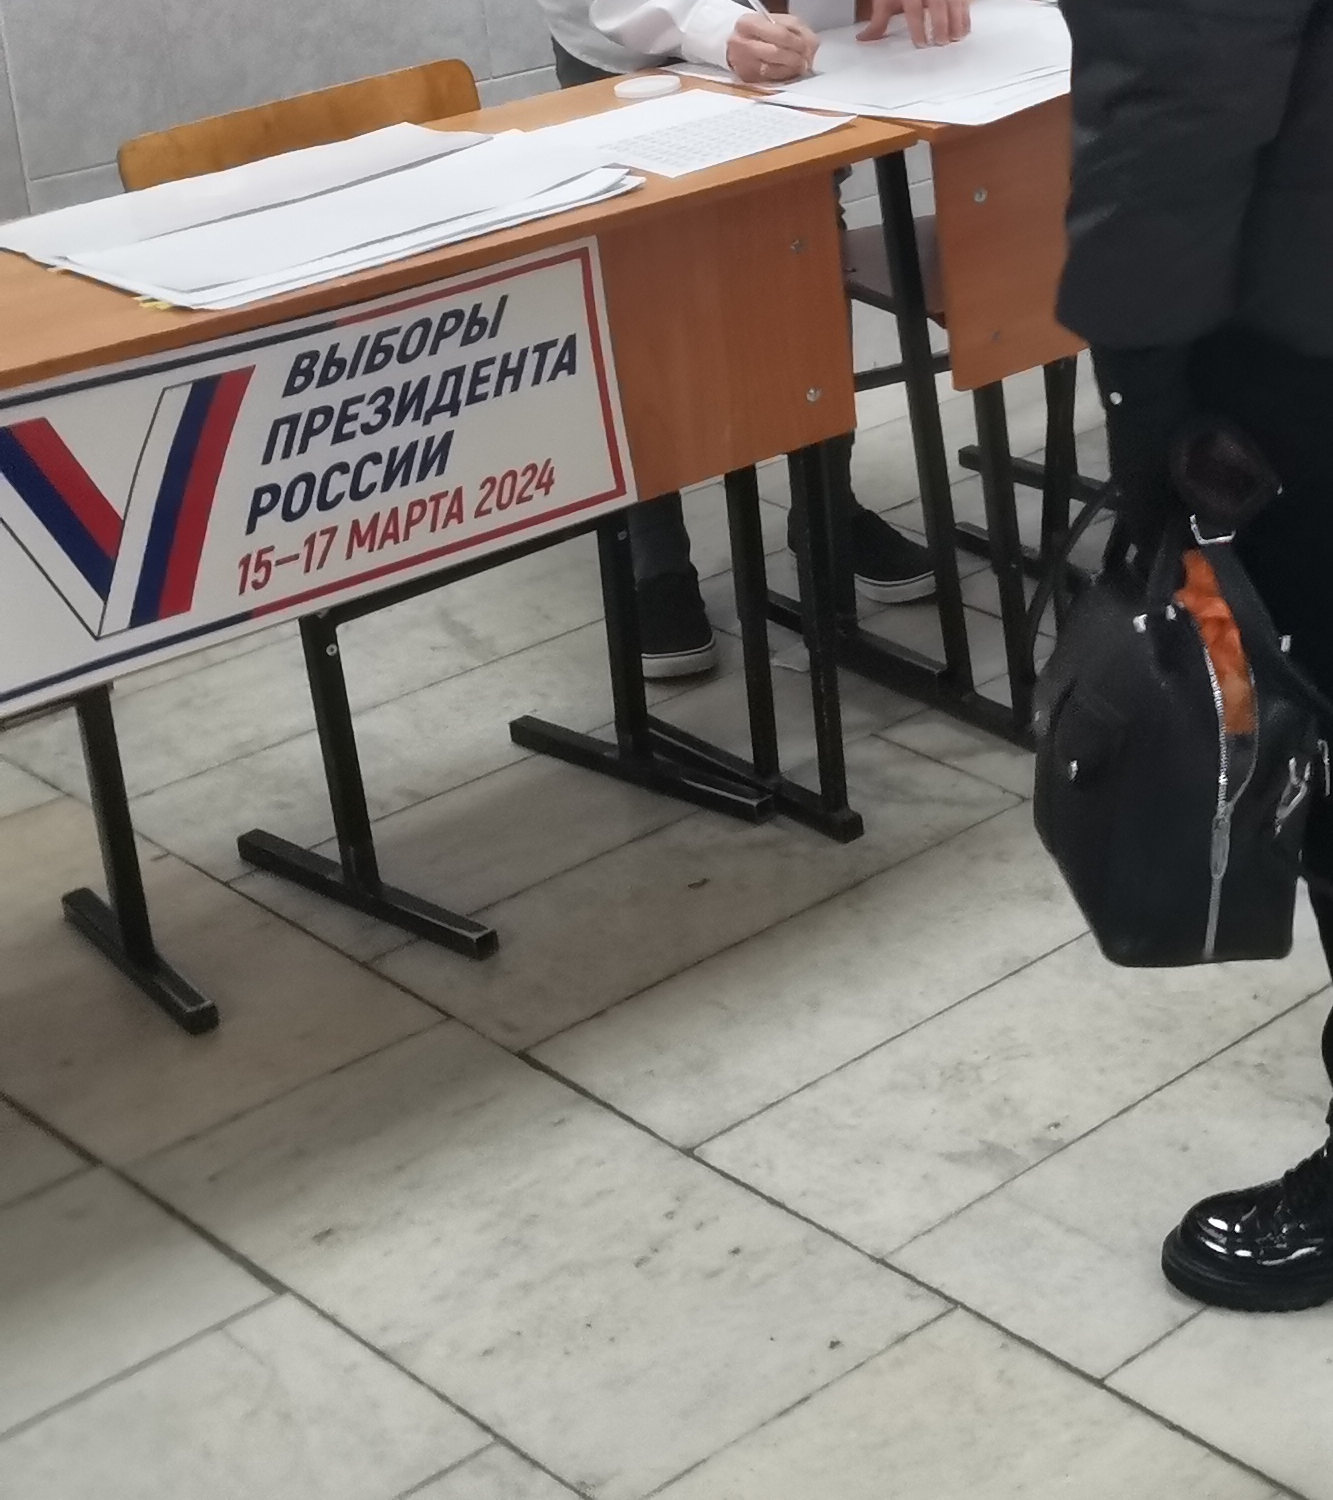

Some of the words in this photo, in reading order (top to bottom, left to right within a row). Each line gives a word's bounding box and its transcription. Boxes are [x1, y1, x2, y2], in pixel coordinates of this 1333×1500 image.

[281, 294, 509, 398] ВЫБОРЫ
[261, 333, 577, 465] ПРЕЗИДЕНТА
[245, 430, 455, 536] РОССИИ
[345, 485, 464, 561] МАРТА
[473, 458, 556, 520] 2024
